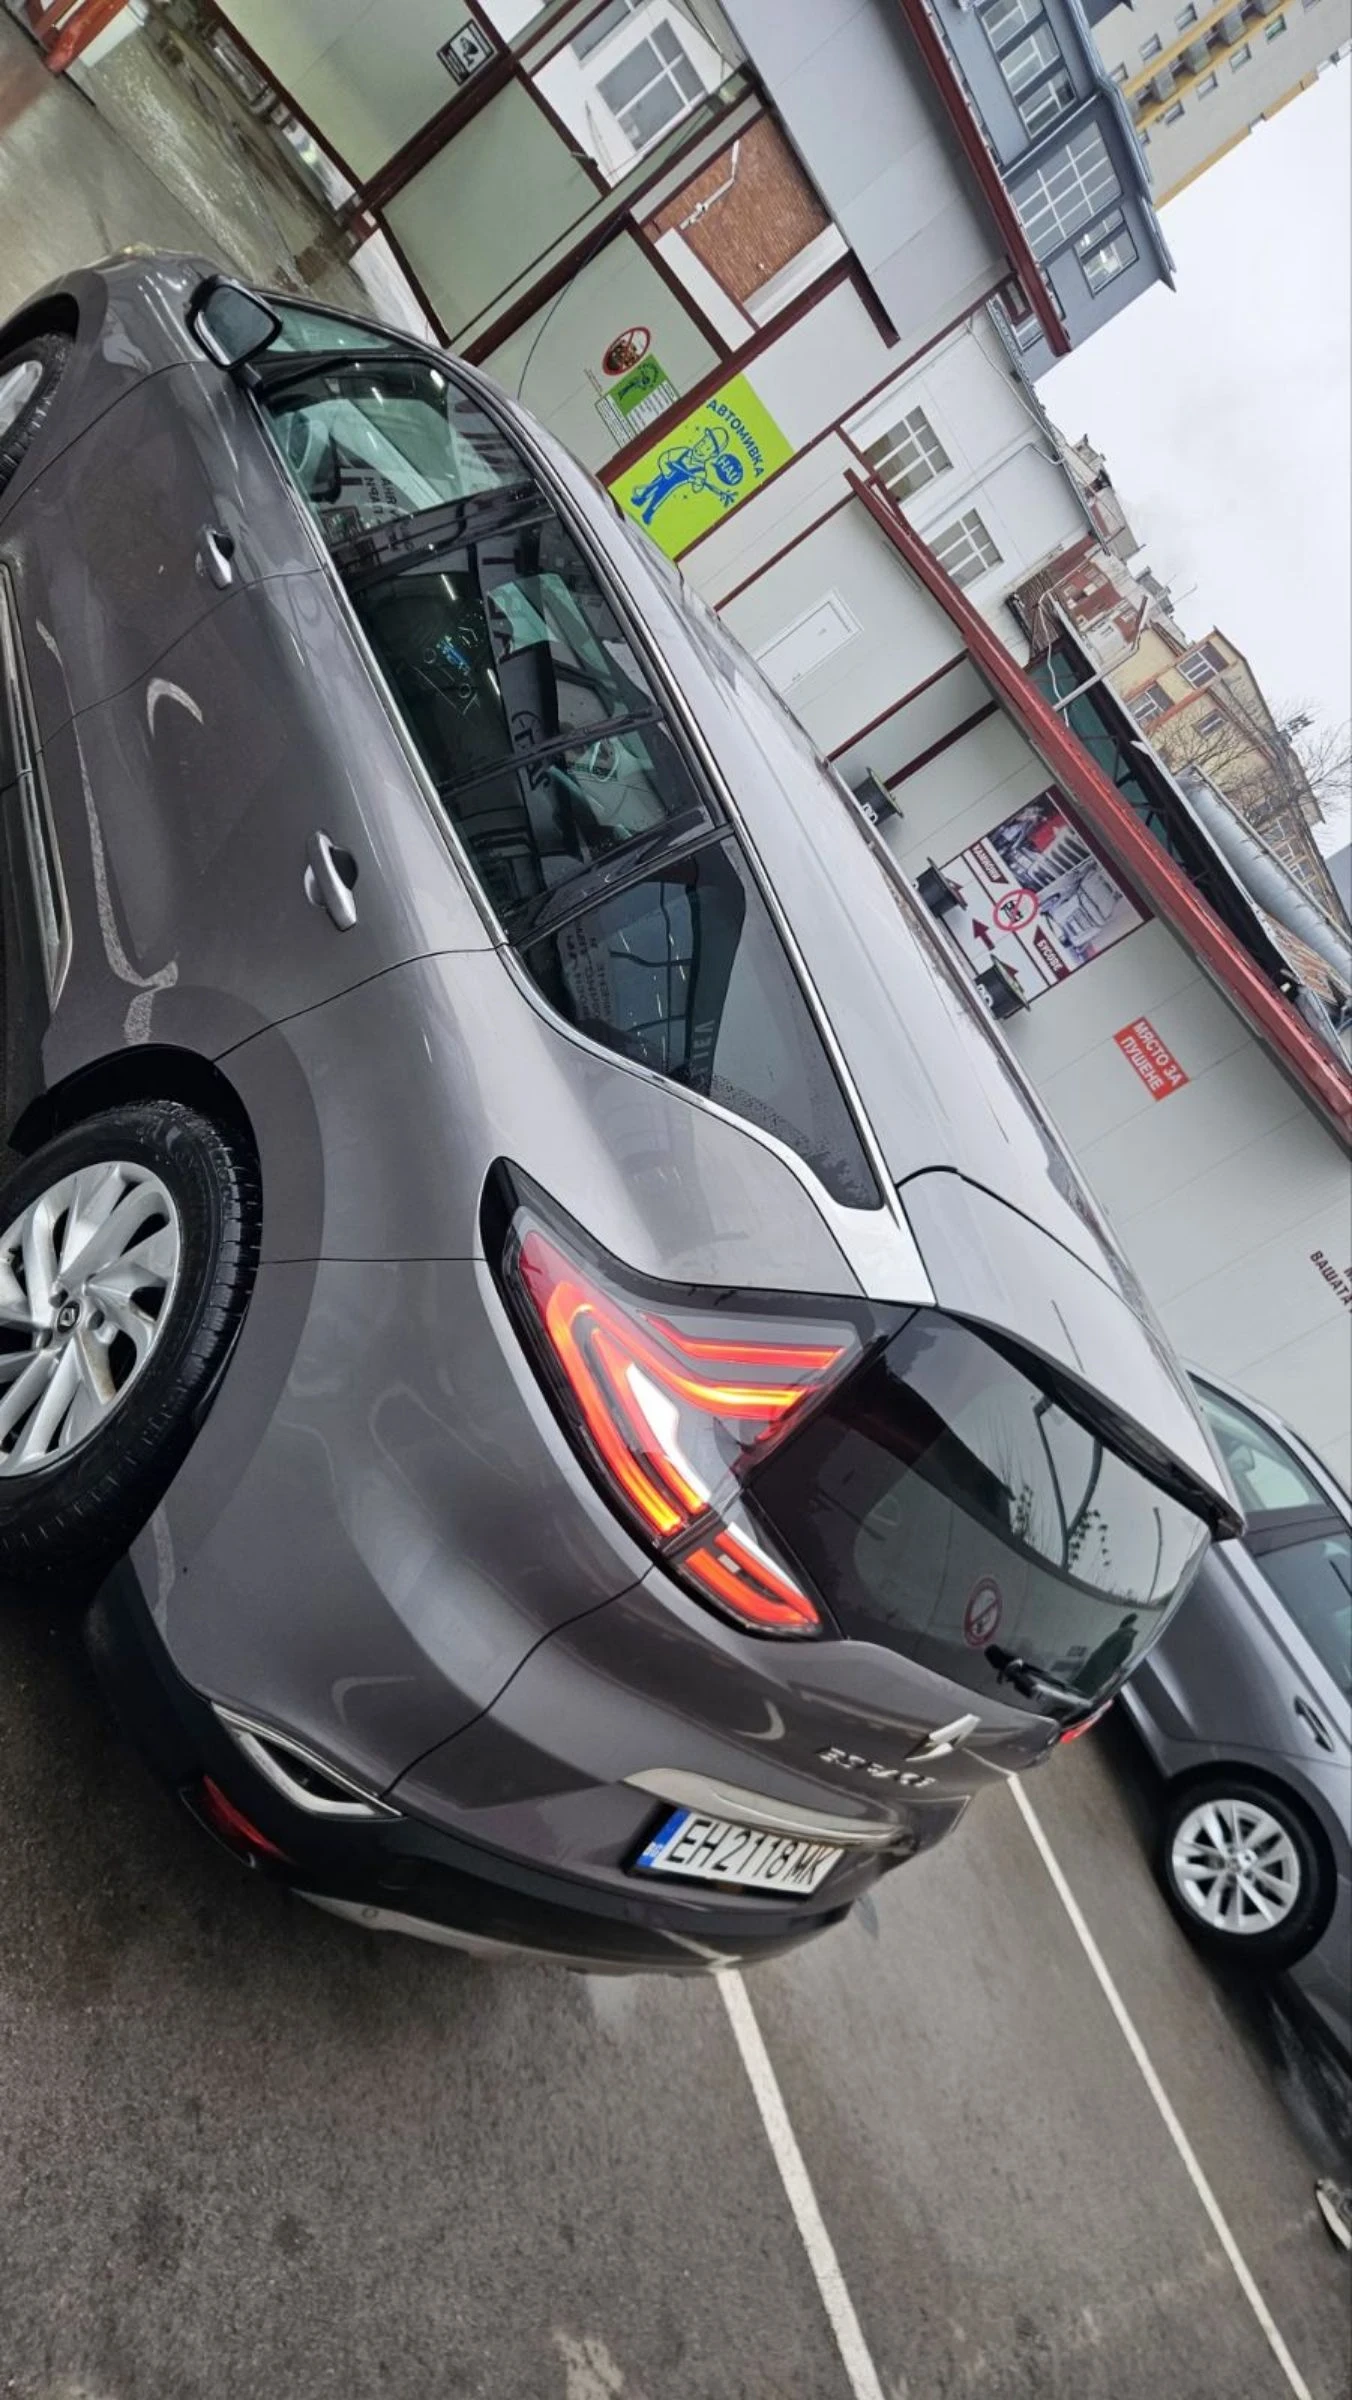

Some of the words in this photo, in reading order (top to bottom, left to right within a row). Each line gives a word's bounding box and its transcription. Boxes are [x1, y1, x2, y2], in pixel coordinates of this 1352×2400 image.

[706, 399, 765, 478] АВТОМИВКА
[1037, 939, 1063, 971] БУСОВЕ
[1120, 1036, 1165, 1091] ПУШЕНЕ
[1132, 1021, 1169, 1066] МЯСТО
[1163, 1064, 1183, 1087] ЗА
